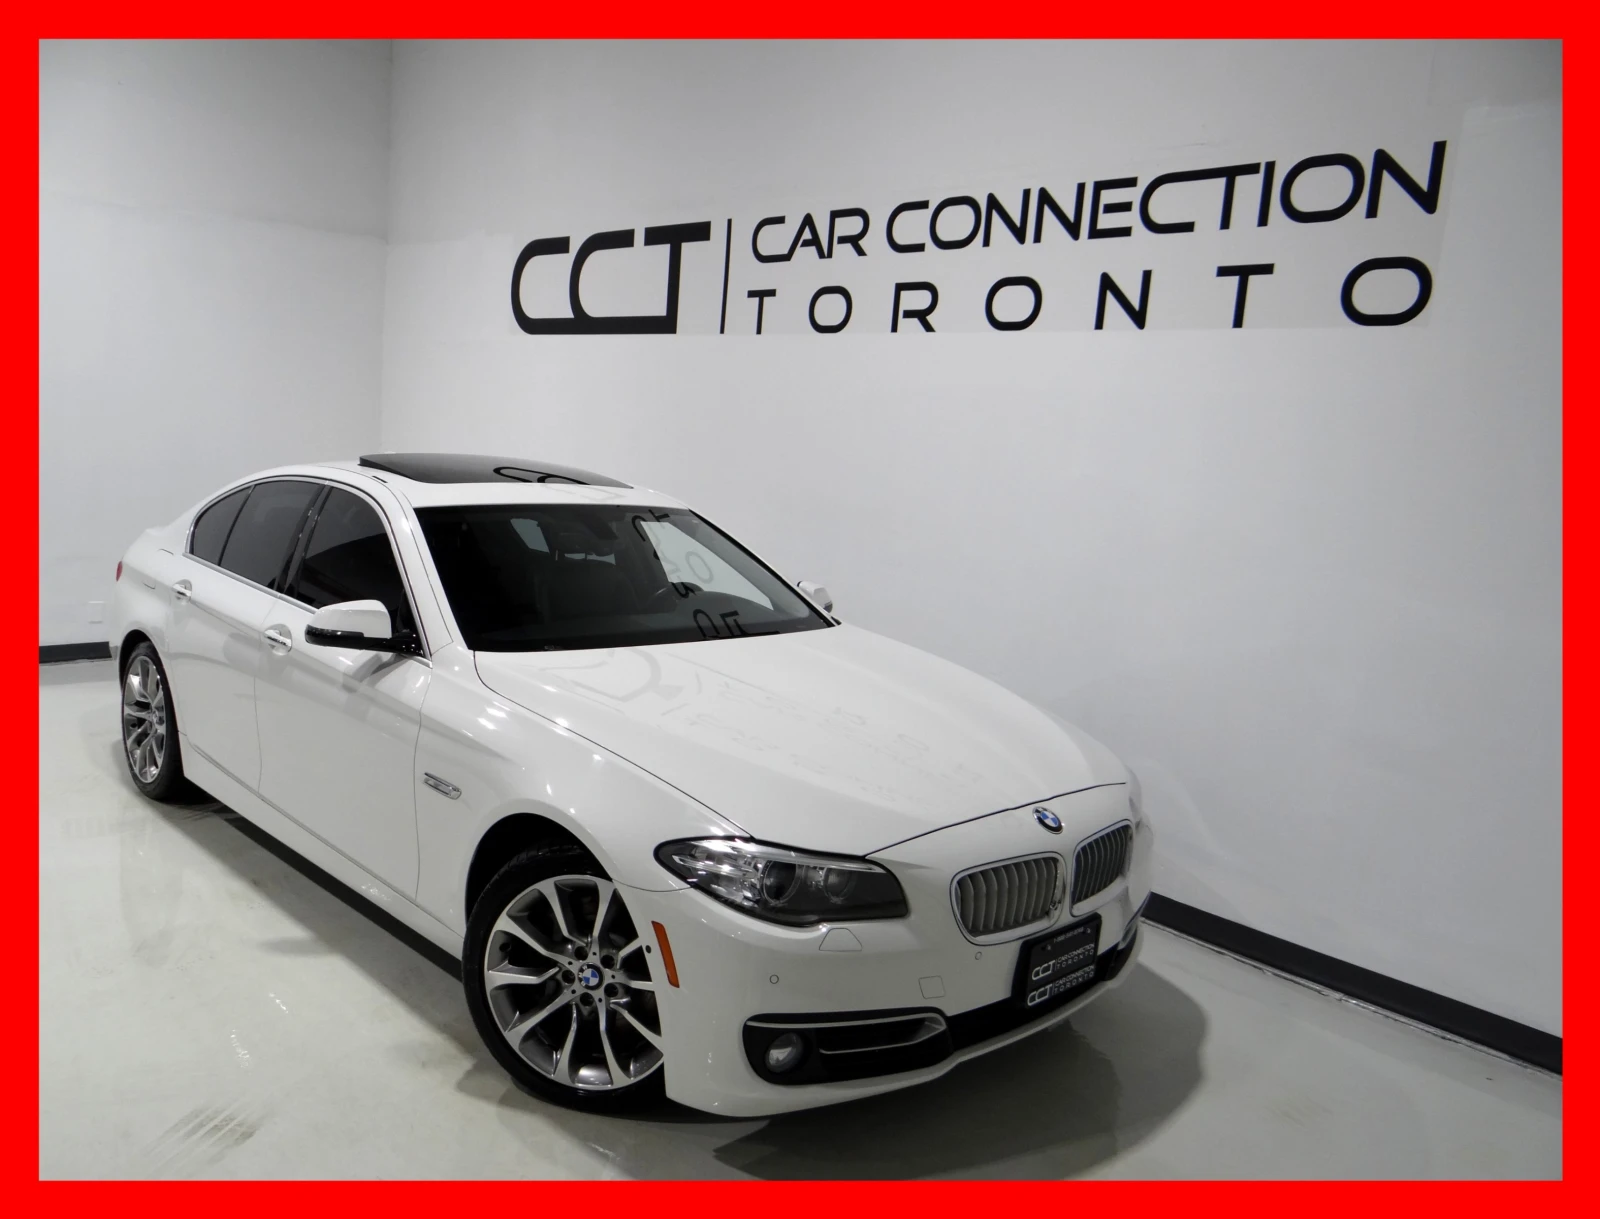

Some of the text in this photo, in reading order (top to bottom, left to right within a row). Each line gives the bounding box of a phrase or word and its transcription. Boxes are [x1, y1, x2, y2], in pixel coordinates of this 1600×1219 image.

[752, 140, 1447, 263] CAR CONNECTION
[511, 221, 711, 334] CCT
[748, 257, 1432, 334] TORONTO
[1027, 983, 1053, 1006] CCT
[1032, 959, 1056, 980] CCT
